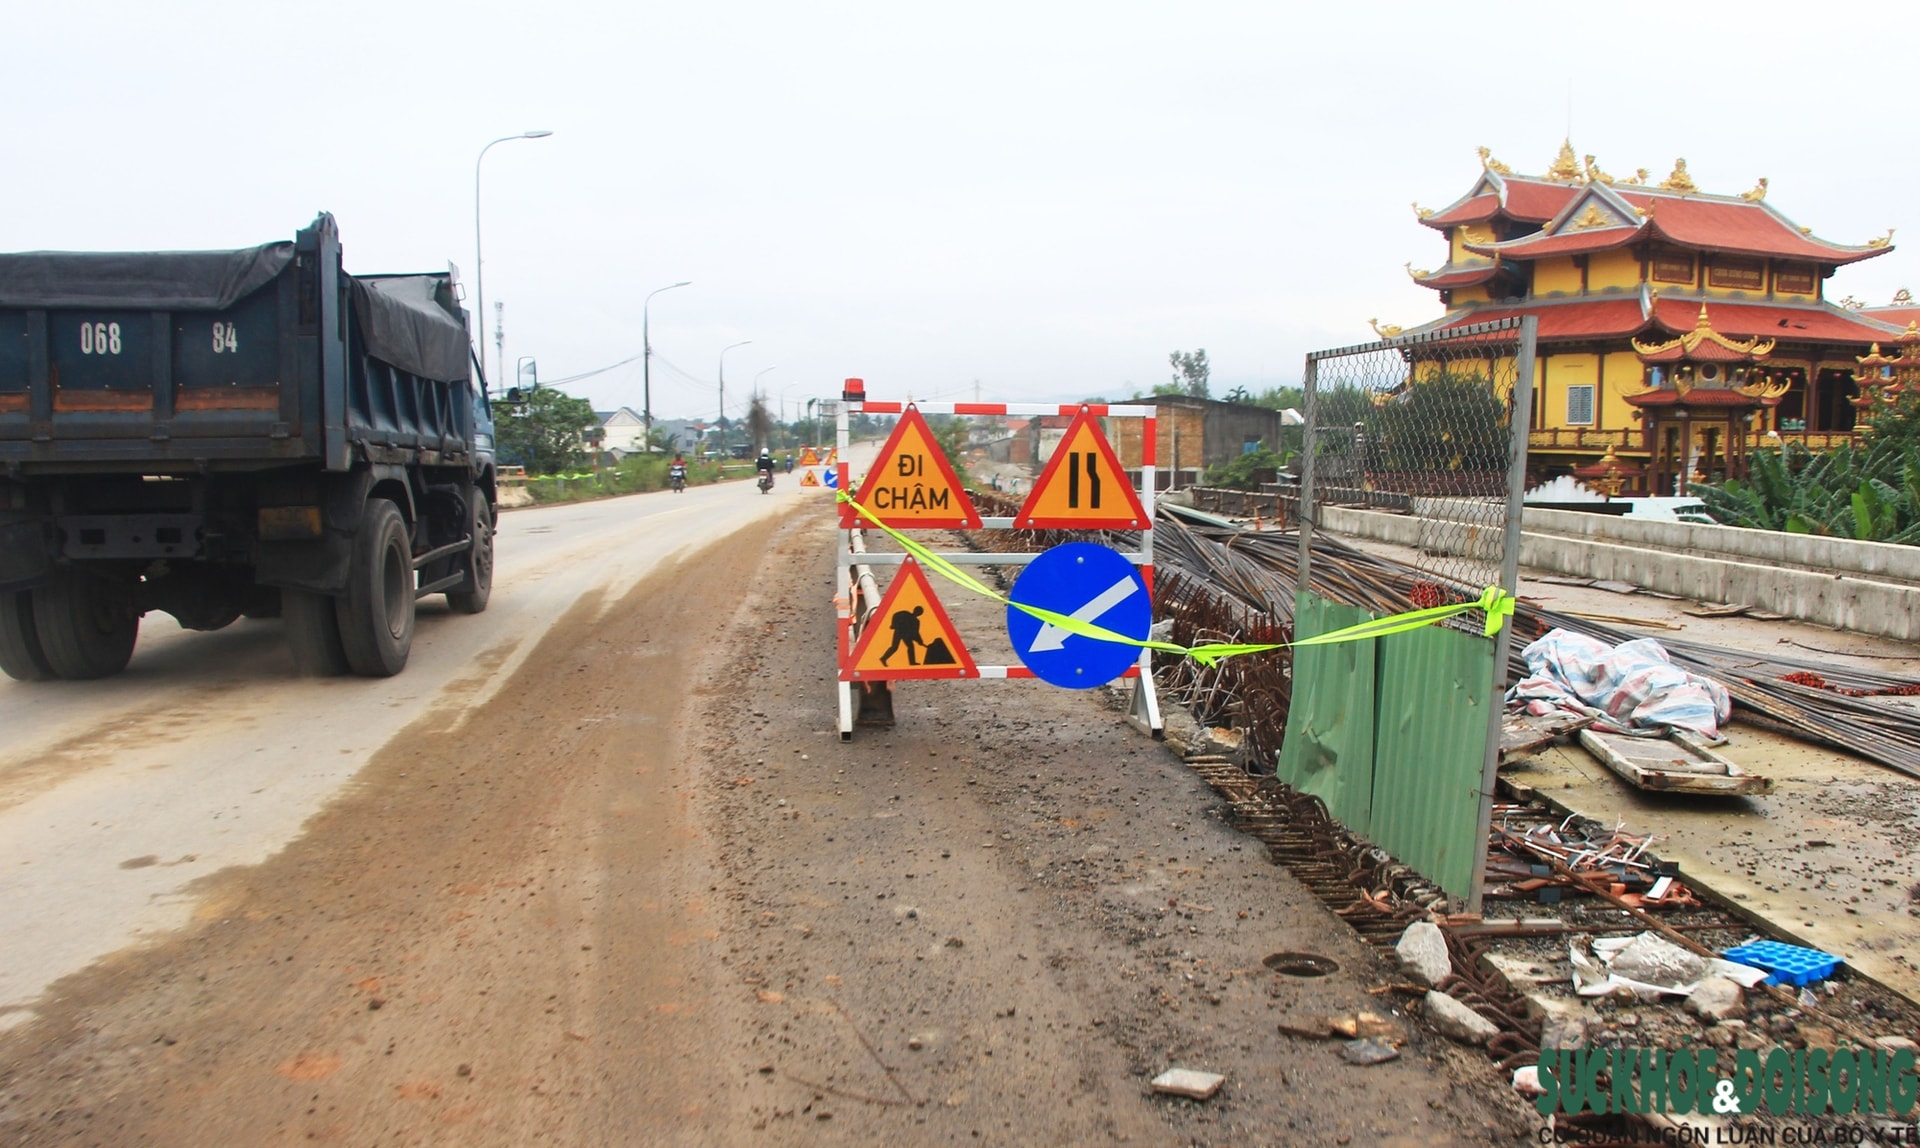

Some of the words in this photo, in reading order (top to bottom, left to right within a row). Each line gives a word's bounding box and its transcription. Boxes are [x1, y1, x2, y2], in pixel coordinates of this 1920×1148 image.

[81, 321, 122, 355] 068
[212, 321, 238, 354] 84
[898, 454, 923, 477] ĐI
[874, 482, 949, 514] CHẬM
